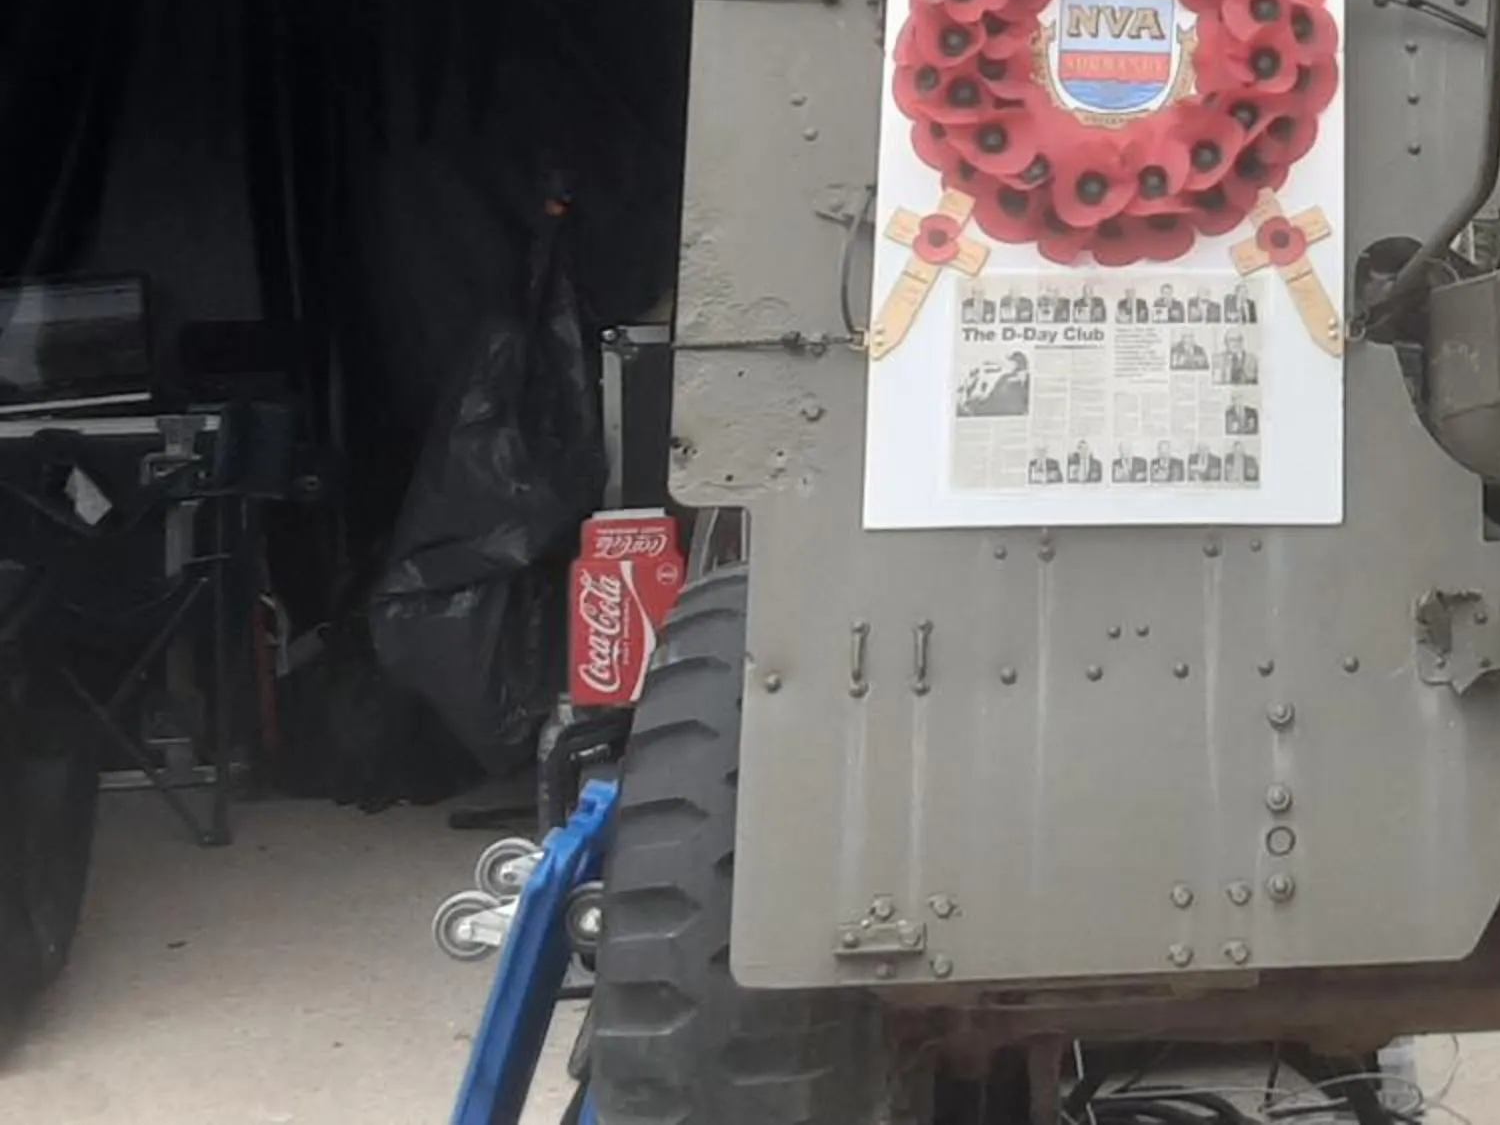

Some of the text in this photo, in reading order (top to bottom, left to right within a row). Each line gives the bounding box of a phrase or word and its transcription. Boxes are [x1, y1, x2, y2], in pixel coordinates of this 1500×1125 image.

[1067, 4, 1167, 41] NVA
[962, 326, 1105, 344] The D-Day Club
[578, 568, 621, 693] Coca-Cola
